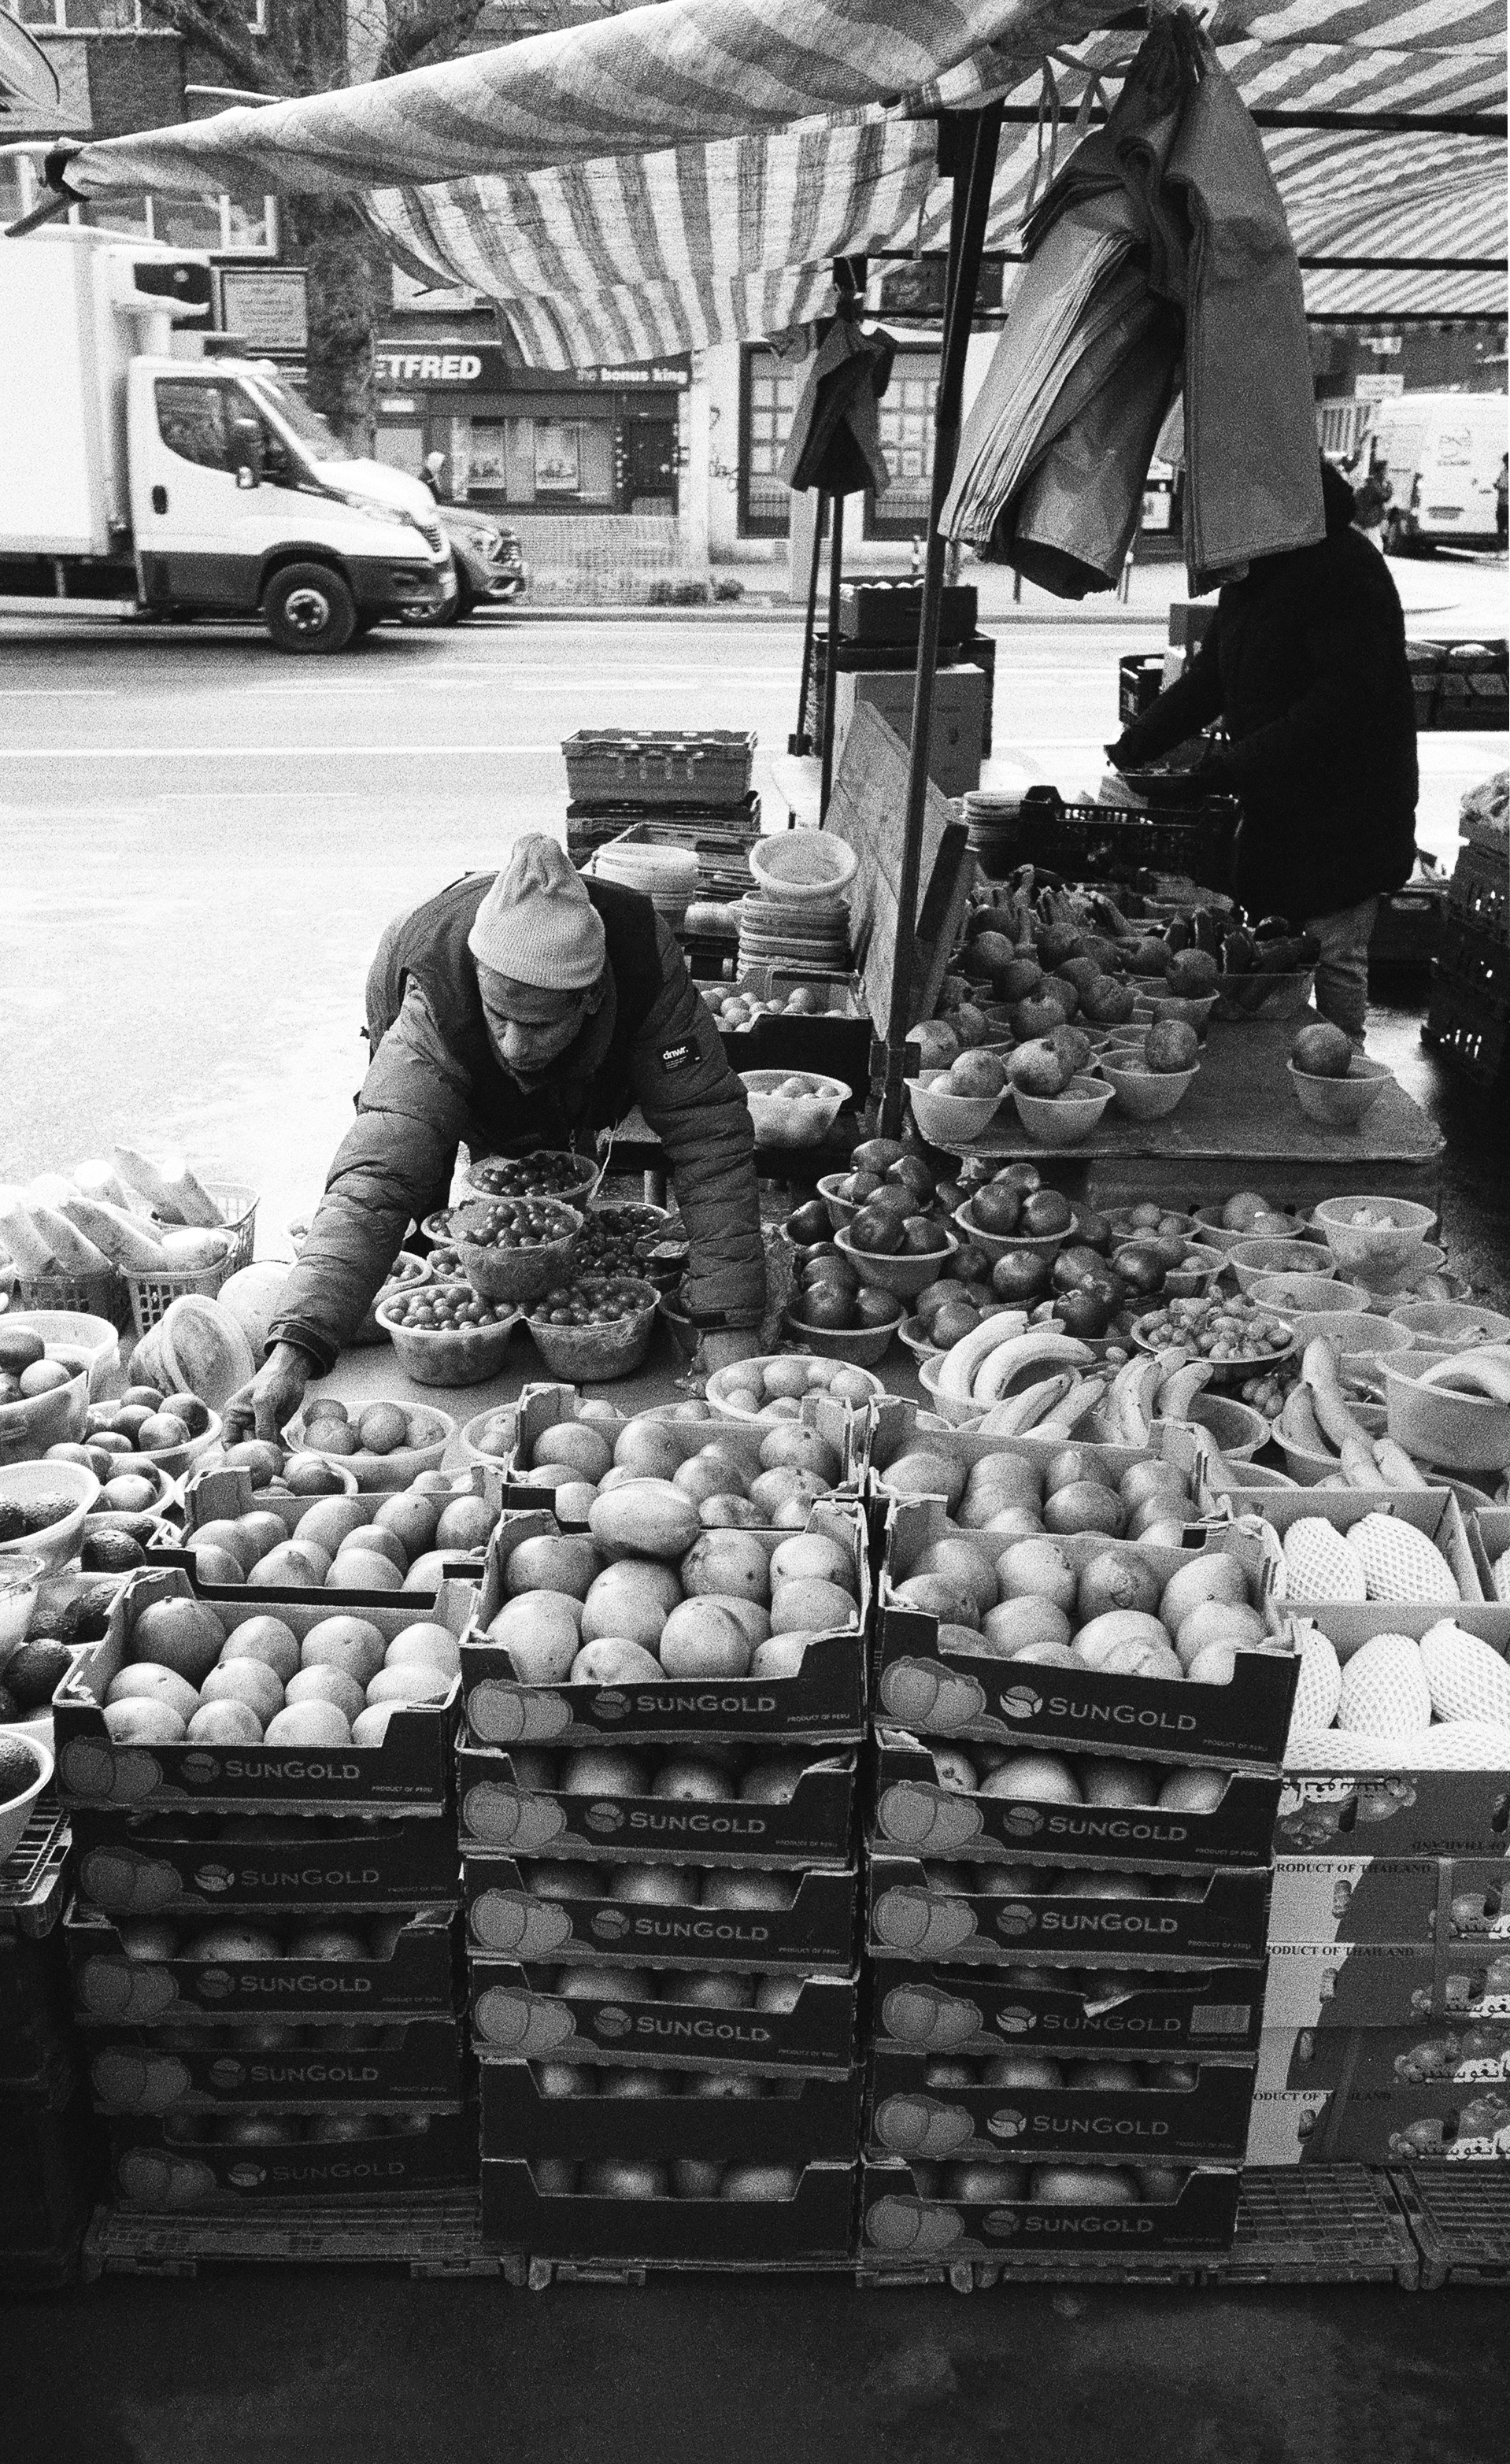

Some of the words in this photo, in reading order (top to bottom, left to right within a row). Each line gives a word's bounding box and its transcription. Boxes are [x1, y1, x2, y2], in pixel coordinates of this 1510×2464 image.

[374, 354, 481, 379] ETFRED
[601, 367, 650, 382] bonus
[653, 368, 688, 384] king
[1276, 1863, 1333, 1873] RODUCT
[1337, 1863, 1354, 1873] OF
[1359, 1863, 1431, 1873] THAILAND
[1267, 1945, 1319, 1955] ODUCT
[1322, 1945, 1340, 1955] OF
[1345, 1946, 1415, 1956] THAILAND
[1253, 2092, 1299, 2101] ODUCT
[1302, 2092, 1319, 2101] OF
